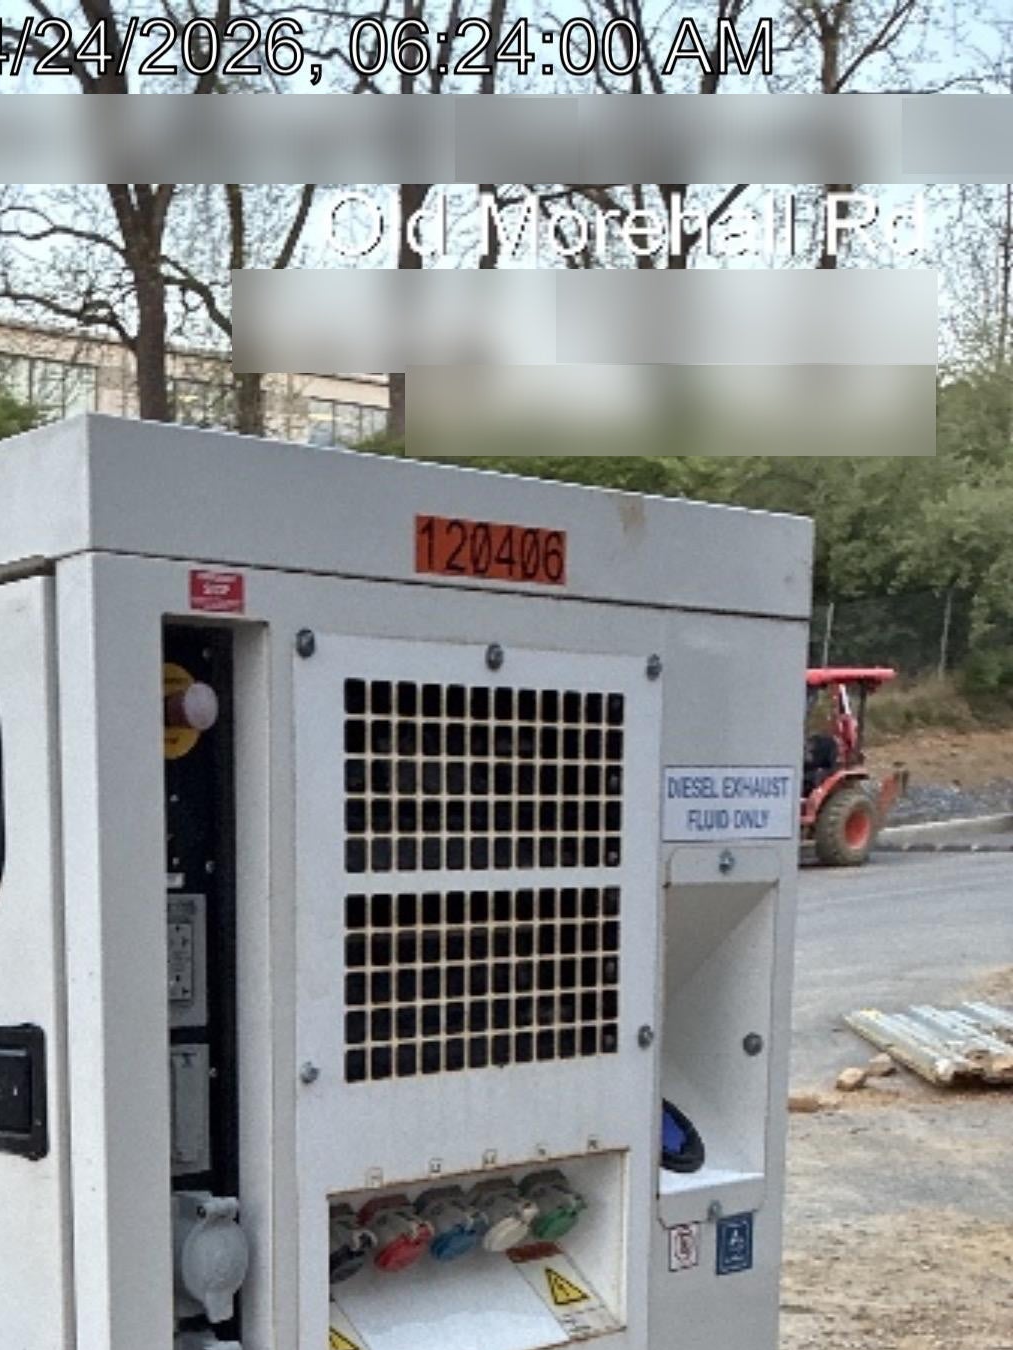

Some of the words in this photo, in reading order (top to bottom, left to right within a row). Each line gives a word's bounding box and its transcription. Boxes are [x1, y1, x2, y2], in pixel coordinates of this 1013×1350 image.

[417, 517, 564, 581] 120406
[668, 776, 719, 799] DIESEL
[722, 776, 790, 799] EXHAUST
[688, 809, 728, 831] FLUID
[733, 809, 770, 829] ONLY
